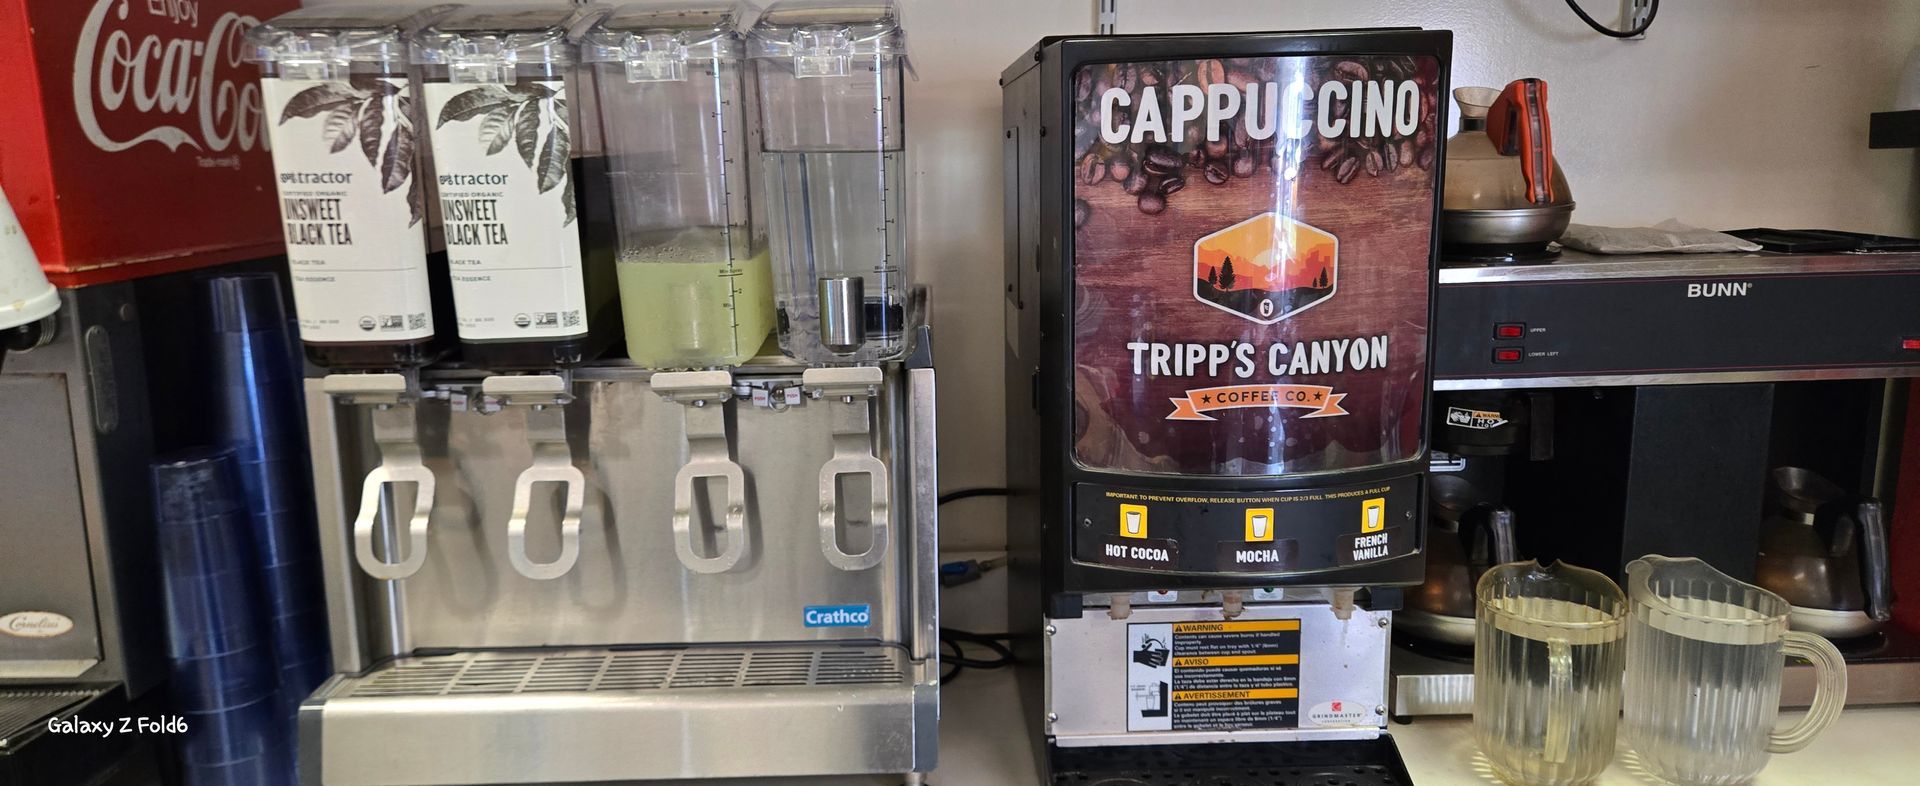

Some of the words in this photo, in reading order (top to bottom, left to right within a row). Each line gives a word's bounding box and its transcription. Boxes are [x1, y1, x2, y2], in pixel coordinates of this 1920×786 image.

[1100, 79, 1420, 144] CAPPUCCINO
[296, 172, 353, 184] tractor
[453, 173, 509, 185] tractor
[284, 198, 341, 220] UNSWEET
[442, 199, 498, 221] UNSWEET
[287, 223, 326, 246] BLACK
[327, 223, 353, 246] TEA
[445, 223, 481, 246] BLACK
[483, 223, 509, 246] TEA
[1126, 340, 1256, 379] TRIPP'S
[1268, 334, 1389, 377] CANYON
[1215, 389, 1280, 404] COFFEE
[1284, 389, 1311, 403] CO.
[1148, 495, 1175, 503] PREVENT
[1337, 490, 1365, 499] PRODUCES
[1354, 532, 1389, 549] FRENCH
[1105, 544, 1128, 559] HOT
[1131, 547, 1170, 562] COCOA
[1236, 550, 1280, 564] MOCHA
[1352, 544, 1389, 561] VANILLA
[806, 609, 869, 624] Crathco
[1184, 691, 1250, 699] AVERTISSEMENT
